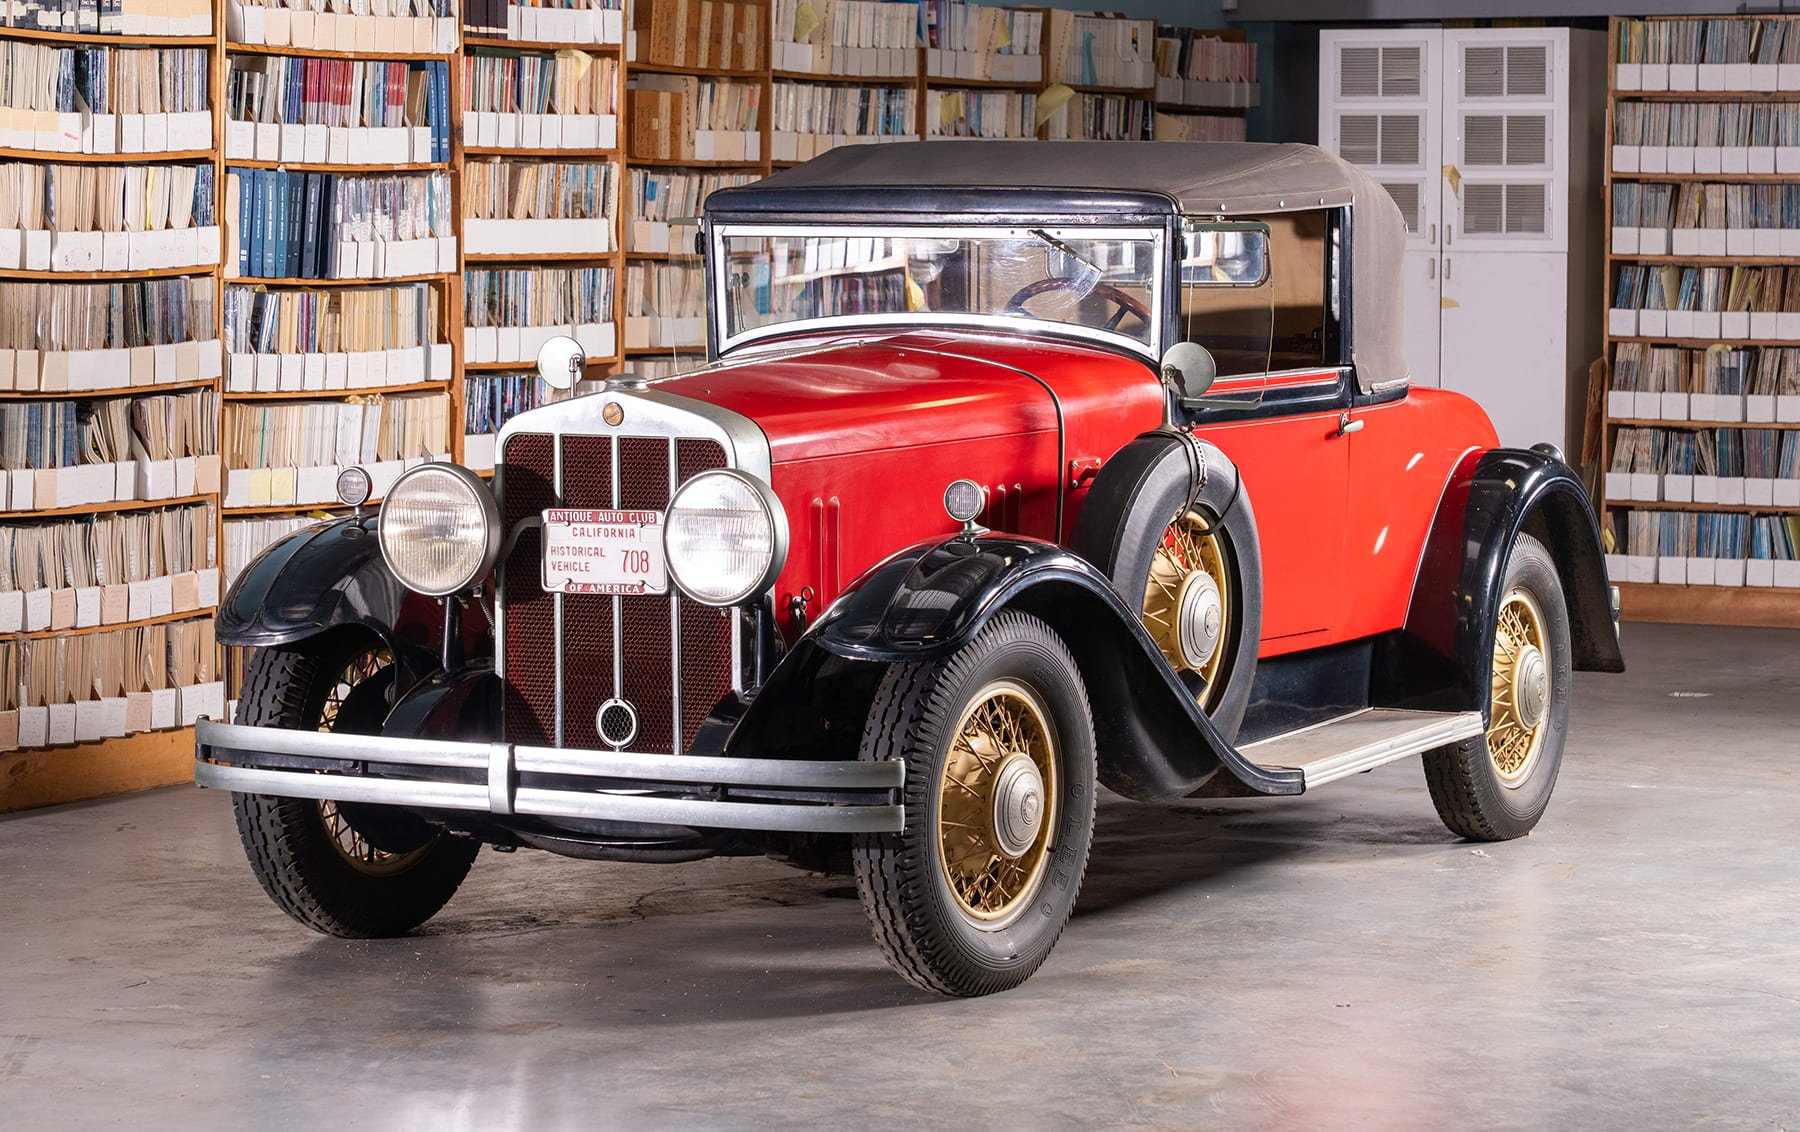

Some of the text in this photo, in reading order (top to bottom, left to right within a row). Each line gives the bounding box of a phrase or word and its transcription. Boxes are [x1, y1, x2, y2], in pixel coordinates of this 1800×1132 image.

[550, 511, 655, 523] ANTIQUE AUTO CLUB
[572, 527, 635, 538] CALIFORNIA
[550, 546, 606, 557] HISTORICAL
[551, 561, 590, 572] VEHICLE
[621, 550, 649, 574] 708
[569, 584, 640, 593] OF AMERICA
[1050, 816, 1082, 892] LEE
